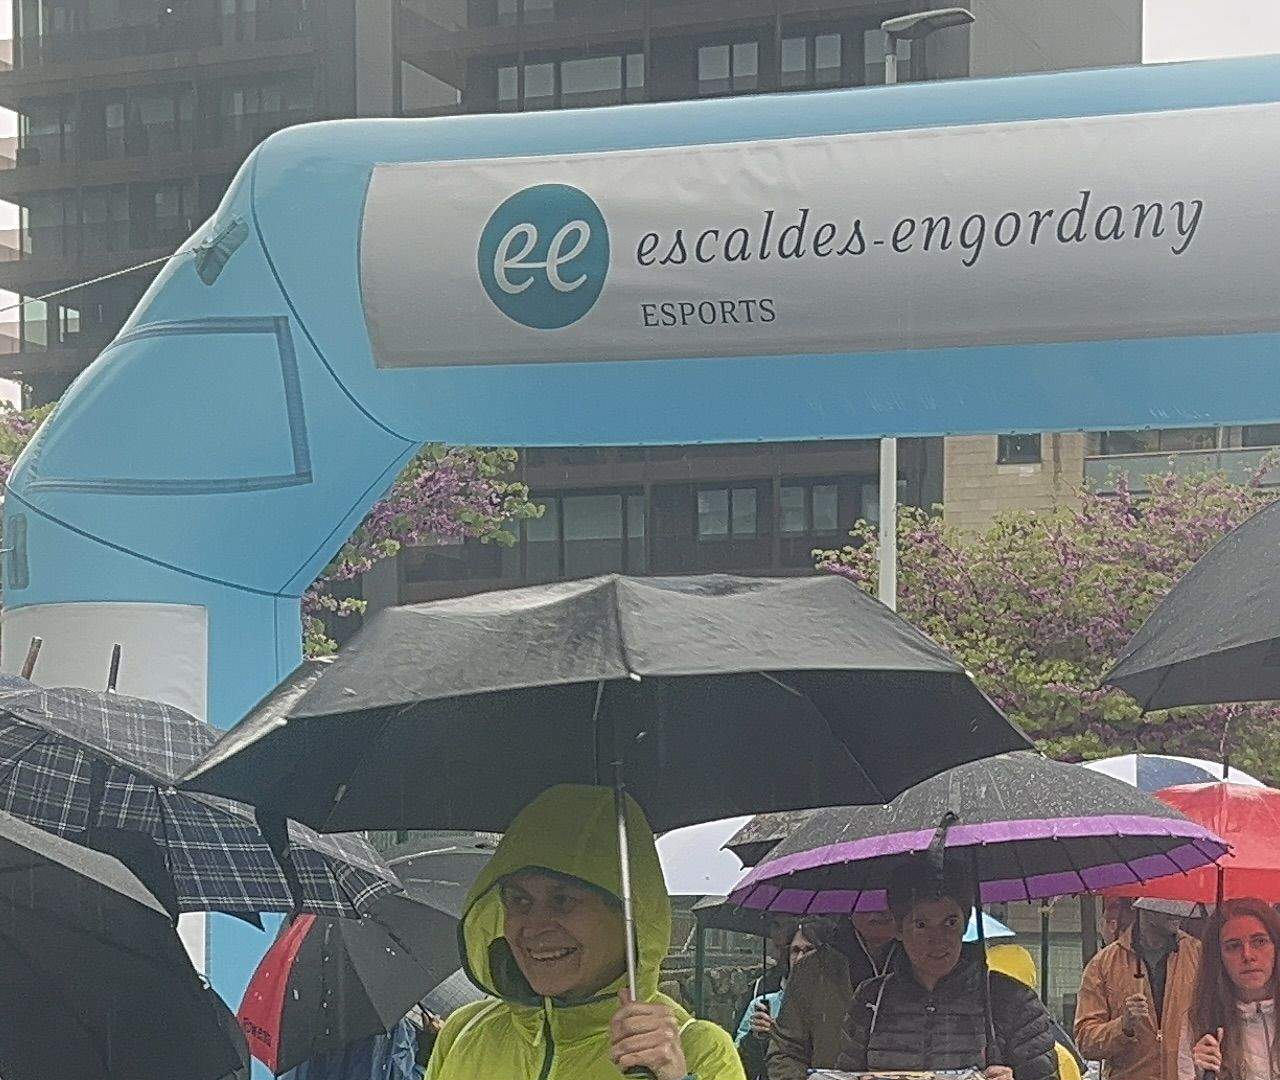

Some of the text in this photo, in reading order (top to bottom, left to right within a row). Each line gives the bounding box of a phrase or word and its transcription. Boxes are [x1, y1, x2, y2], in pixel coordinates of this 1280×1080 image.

[494, 220, 591, 294] ee
[636, 190, 1204, 268] escaldes-engordany
[641, 299, 776, 327] ESPORTS
